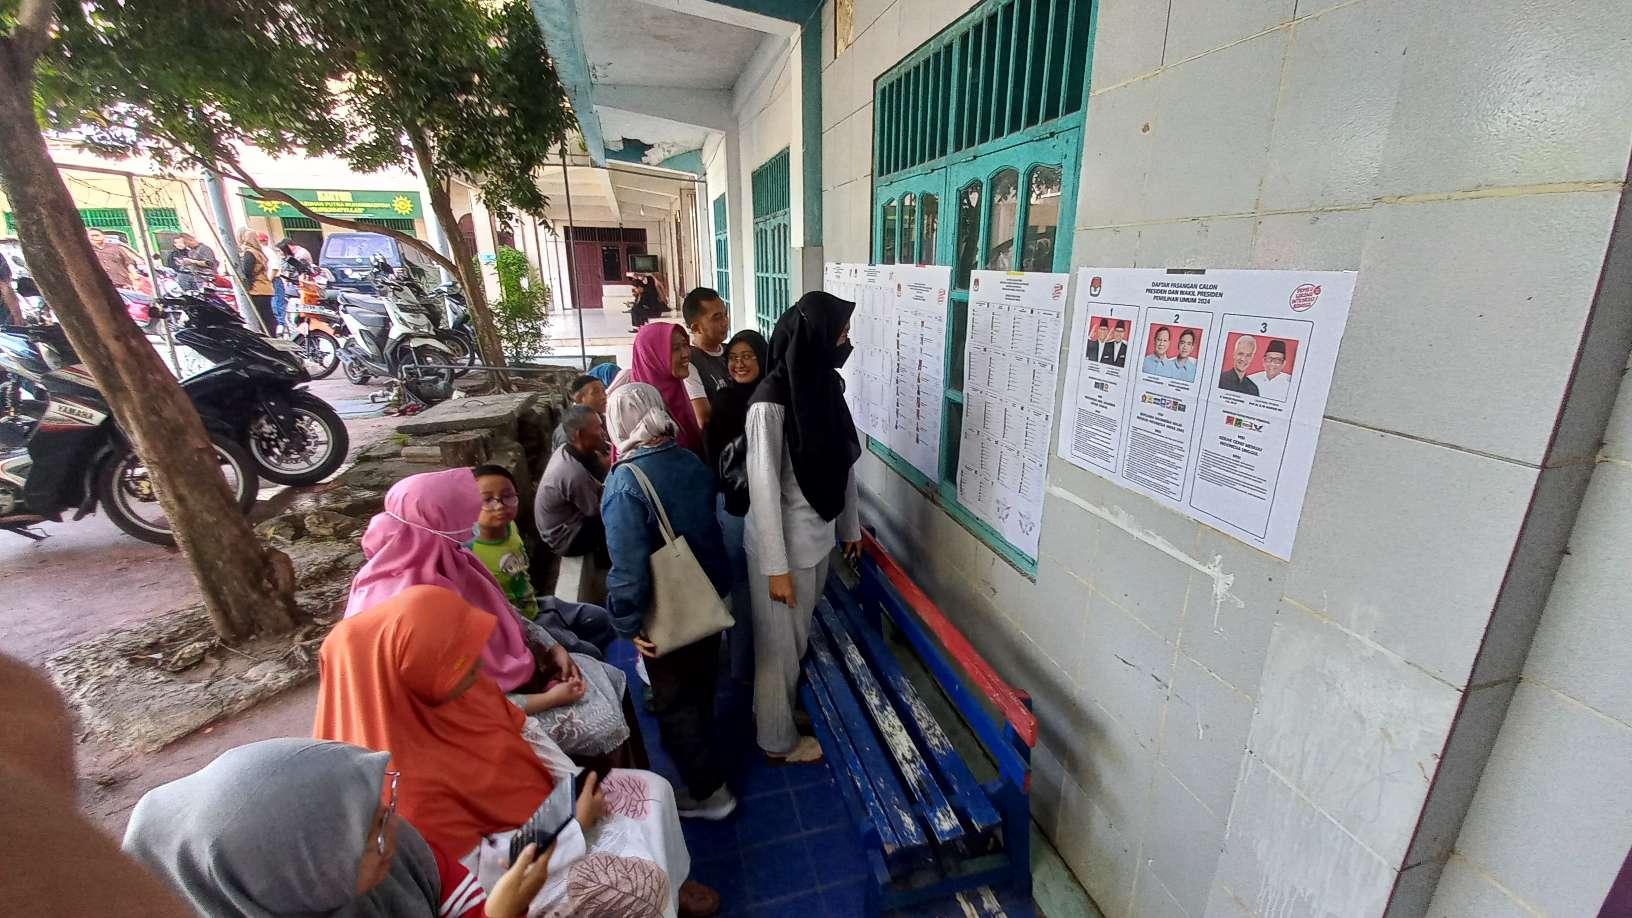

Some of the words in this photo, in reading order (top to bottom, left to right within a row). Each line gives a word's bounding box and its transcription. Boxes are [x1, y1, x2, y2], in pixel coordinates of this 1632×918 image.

[1173, 314, 1180, 324] 2
[1260, 322, 1268, 333] 3
[57, 404, 95, 420] YAMAHA
